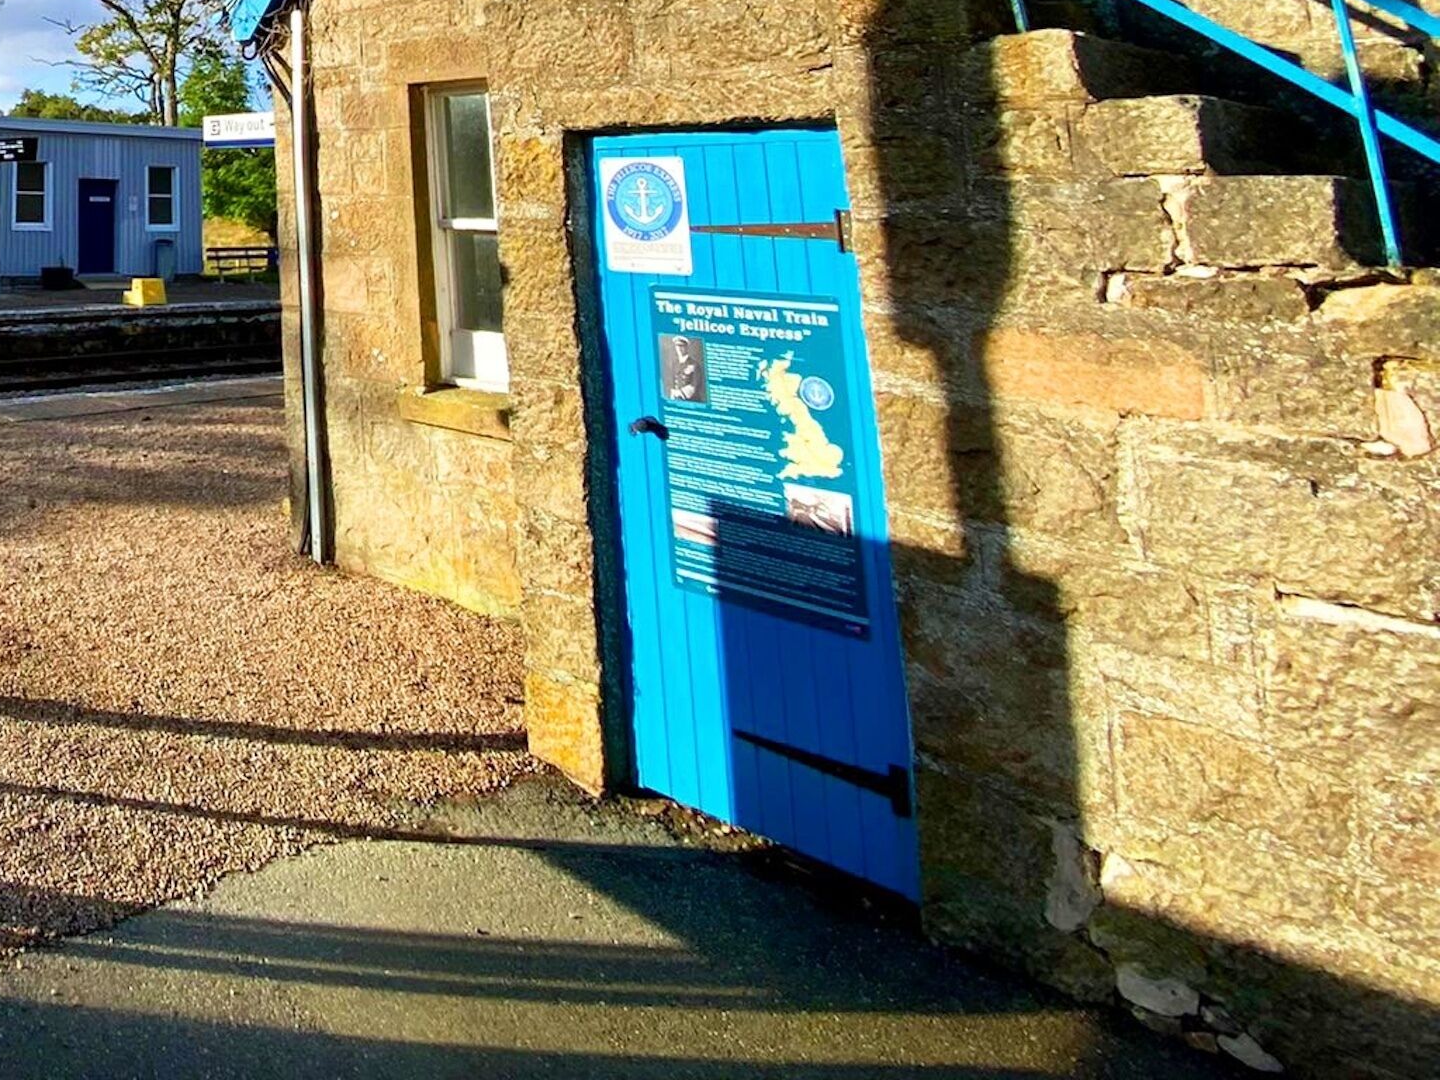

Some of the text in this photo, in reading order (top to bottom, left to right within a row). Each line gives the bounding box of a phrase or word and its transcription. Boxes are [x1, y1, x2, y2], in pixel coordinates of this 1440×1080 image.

[225, 119, 264, 134] Way out
[655, 300, 829, 326] The Royal Naval Train
